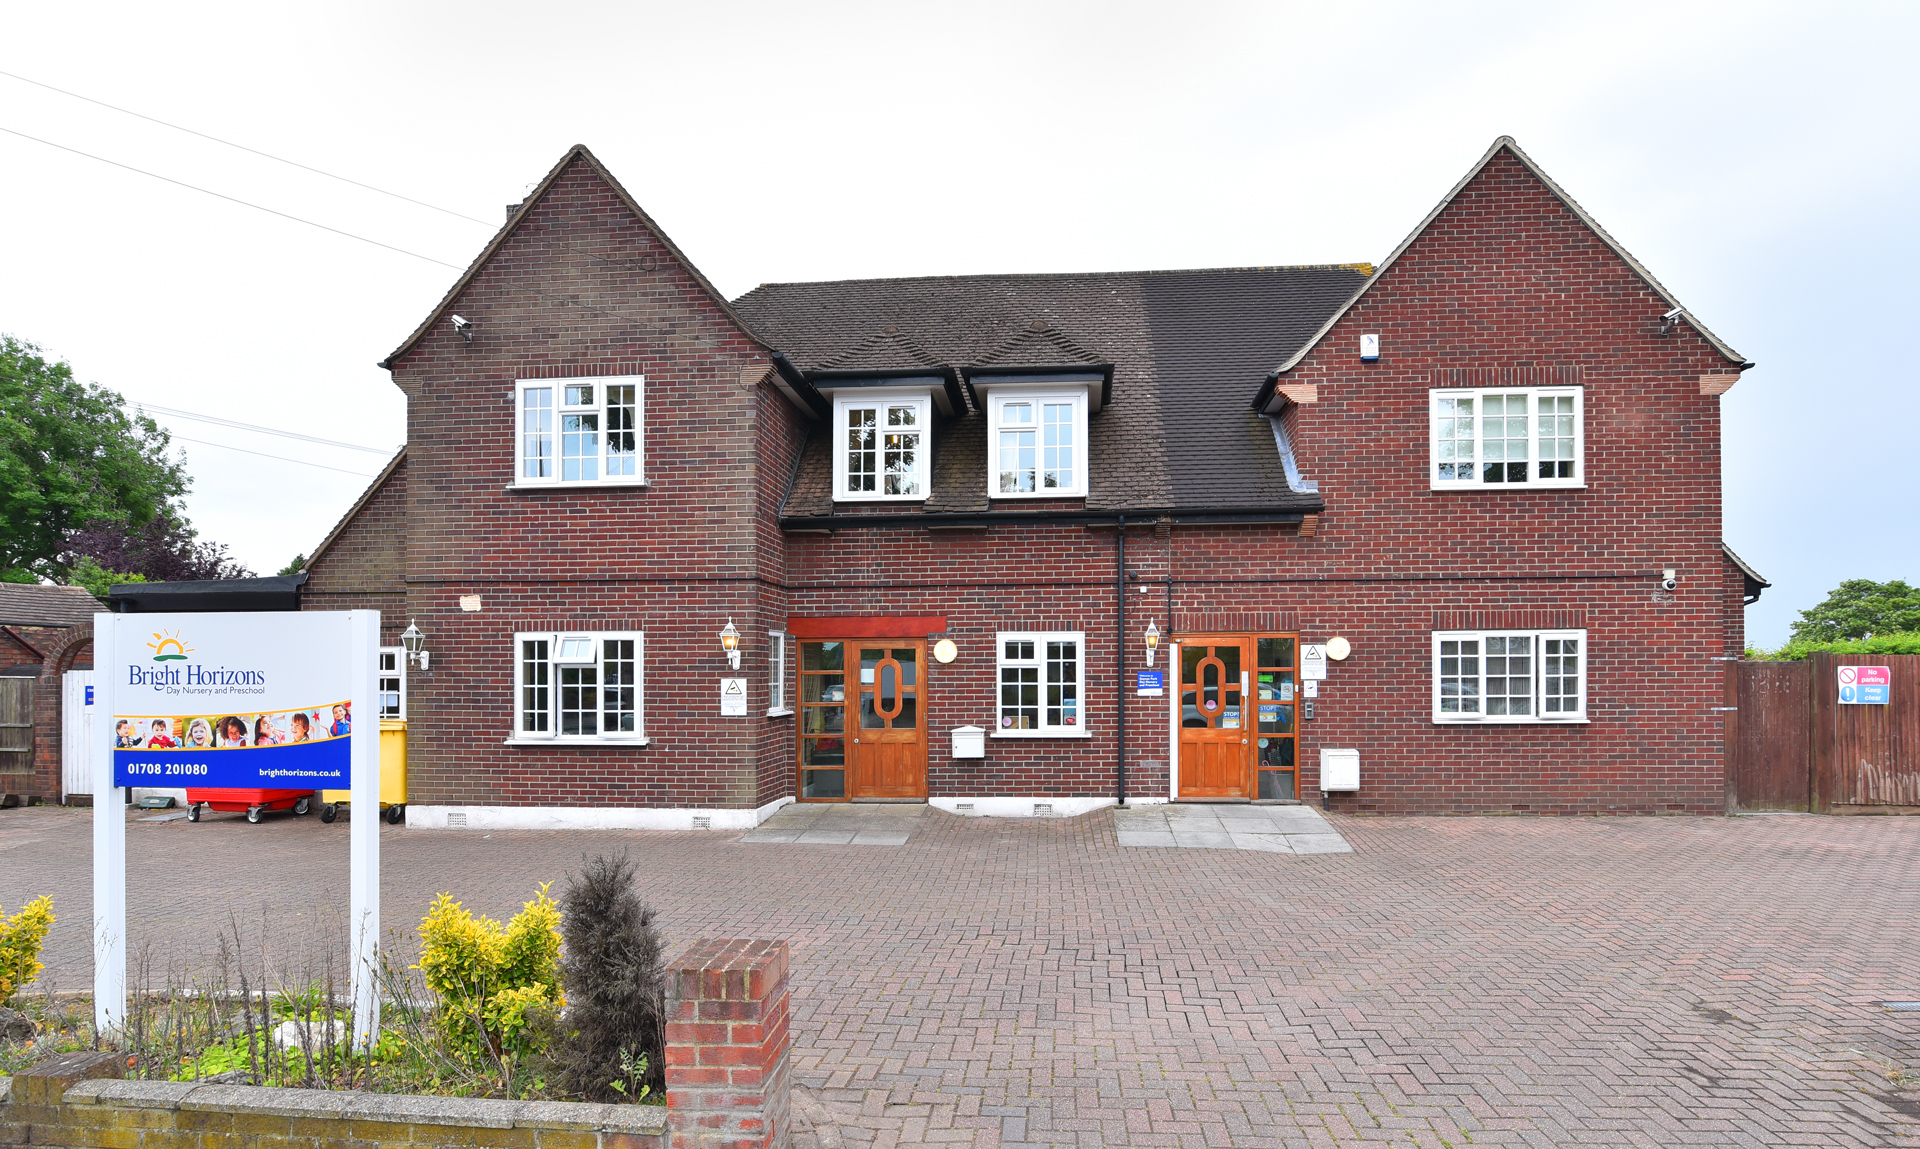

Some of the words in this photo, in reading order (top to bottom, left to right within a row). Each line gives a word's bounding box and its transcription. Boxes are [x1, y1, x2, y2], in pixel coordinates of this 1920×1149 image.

[128, 664, 181, 691] Bright
[186, 664, 265, 685] Horizons
[166, 686, 180, 695] Day
[182, 686, 213, 696] Nursery
[214, 686, 227, 694] and
[229, 686, 265, 694] Preschool
[127, 763, 162, 775] 01708
[165, 764, 208, 775] 201080
[259, 768, 341, 777] brighthorizons.co.uk
